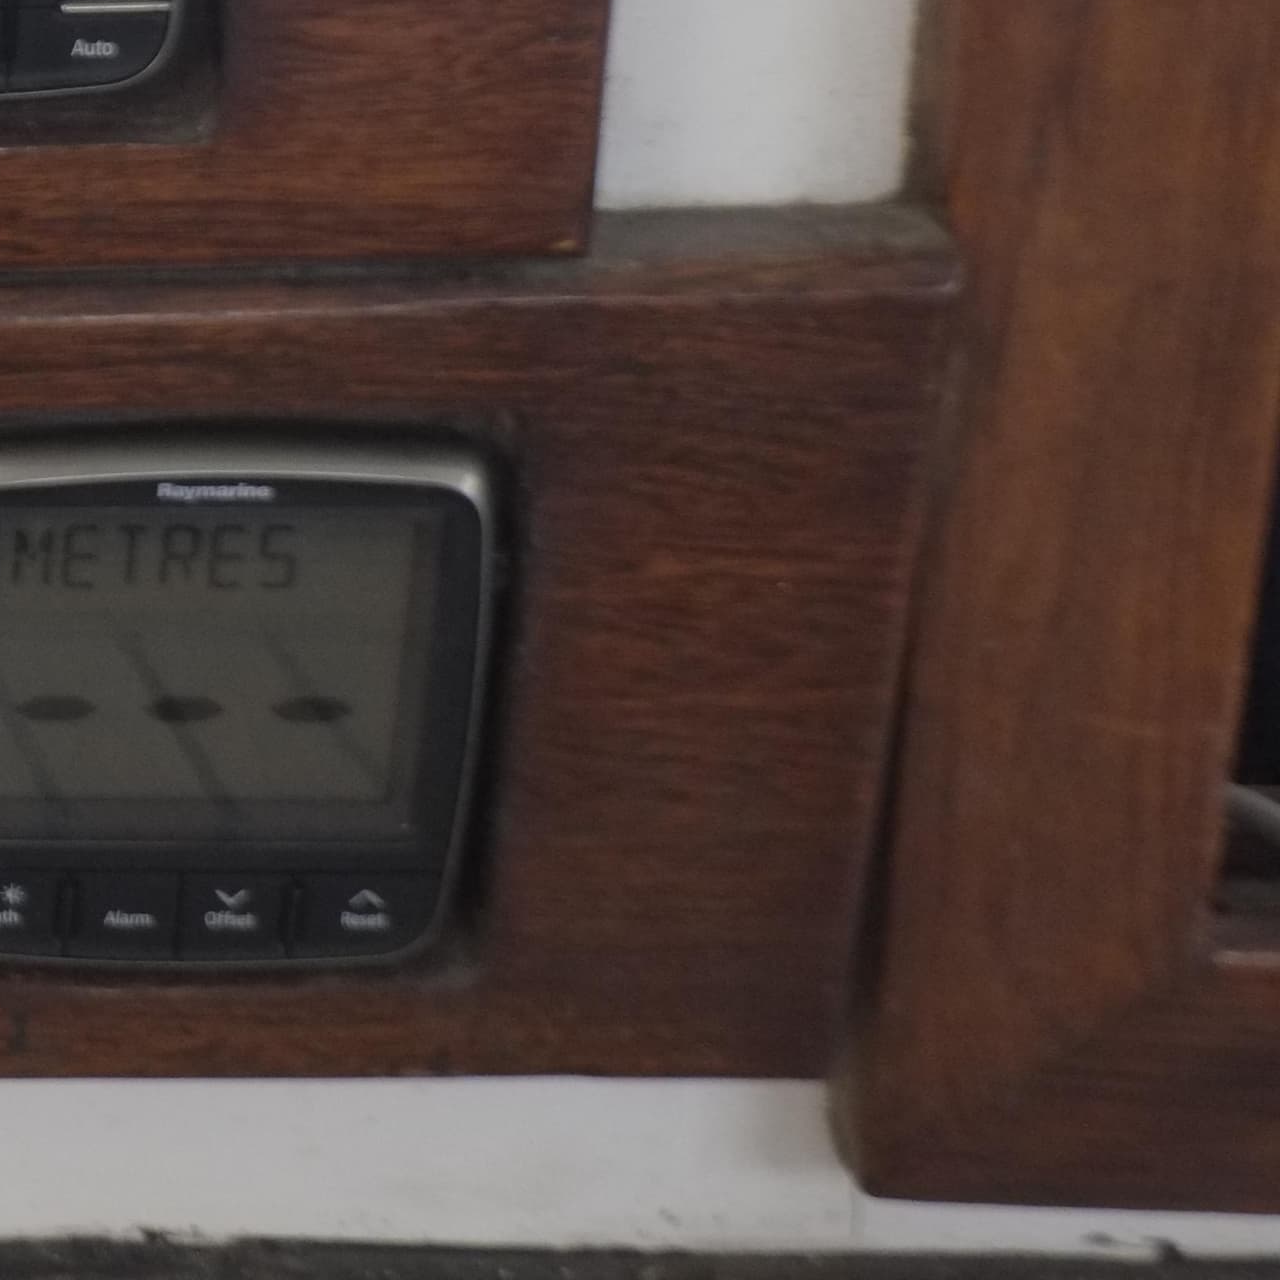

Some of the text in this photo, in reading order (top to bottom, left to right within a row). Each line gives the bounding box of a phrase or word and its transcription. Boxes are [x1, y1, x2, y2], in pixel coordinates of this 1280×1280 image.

[70, 39, 116, 57] Auto
[157, 482, 272, 501] Raymarine
[14, 523, 299, 590] METRES
[102, 910, 152, 926] Alarm
